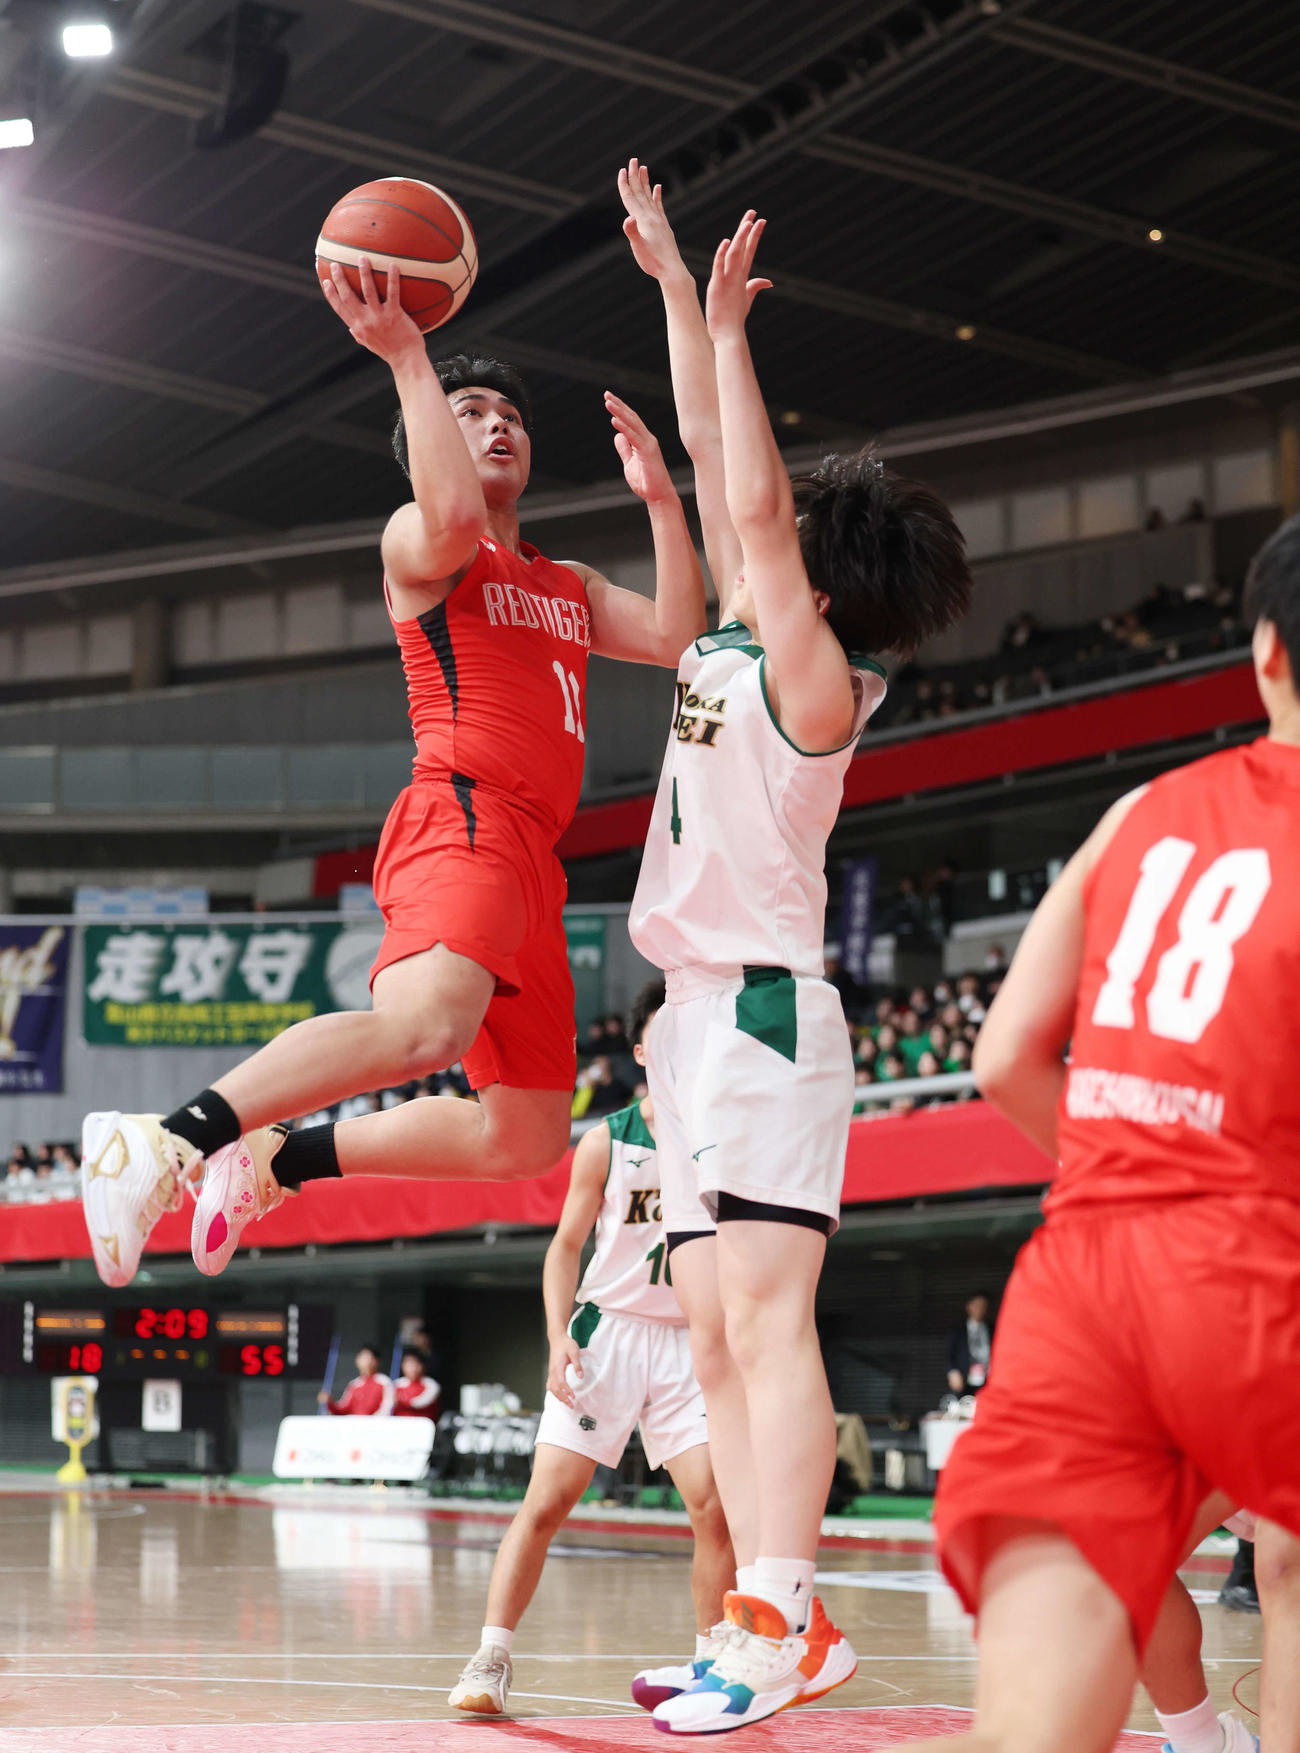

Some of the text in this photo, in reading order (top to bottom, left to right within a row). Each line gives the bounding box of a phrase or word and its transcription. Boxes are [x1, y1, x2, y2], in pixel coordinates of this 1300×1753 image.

[1091, 835, 1271, 1043] 18
[88, 930, 314, 1003] 走攻守
[135, 1307, 208, 1339] 2:09
[241, 1344, 285, 1375] 55
